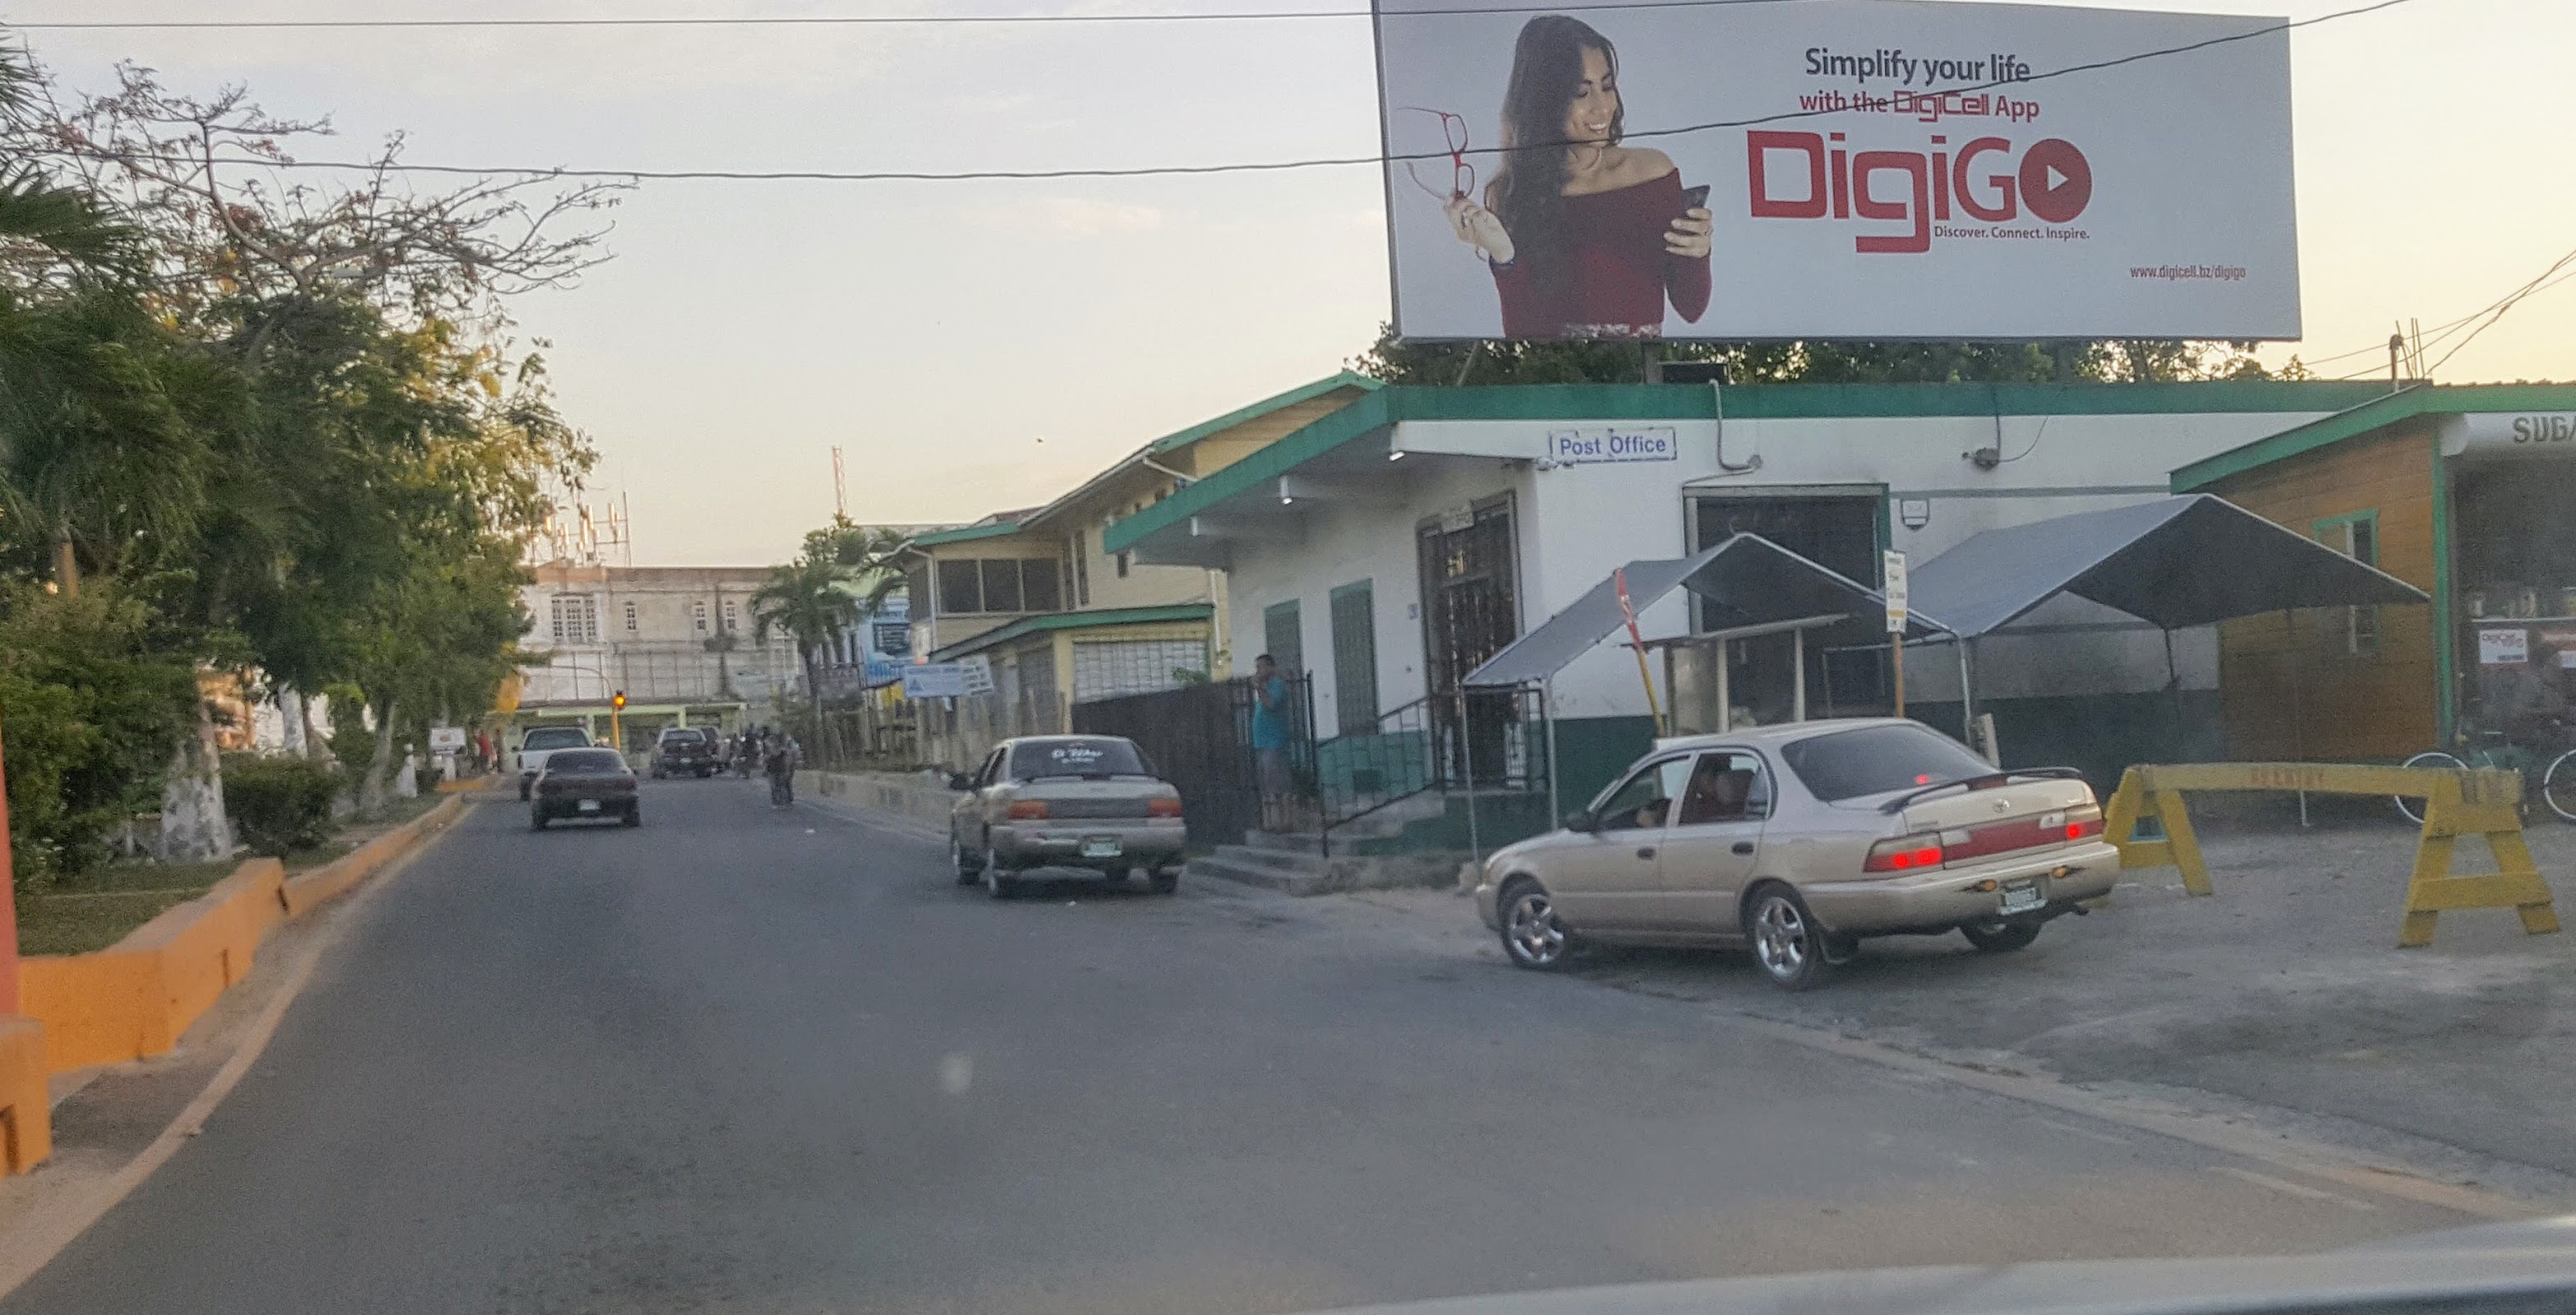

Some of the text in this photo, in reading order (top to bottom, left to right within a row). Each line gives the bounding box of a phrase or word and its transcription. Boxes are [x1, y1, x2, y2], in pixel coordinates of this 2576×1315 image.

[1805, 48, 2030, 86] Simplify your life
[1800, 90, 1846, 112] with
[1852, 91, 1888, 113] the
[1994, 95, 2039, 122] App
[1933, 226, 2090, 242] Discover. Connect. Inspire.
[2130, 265, 2247, 281] www.digicell.bz/digigo
[1560, 436, 1666, 456] Post Office
